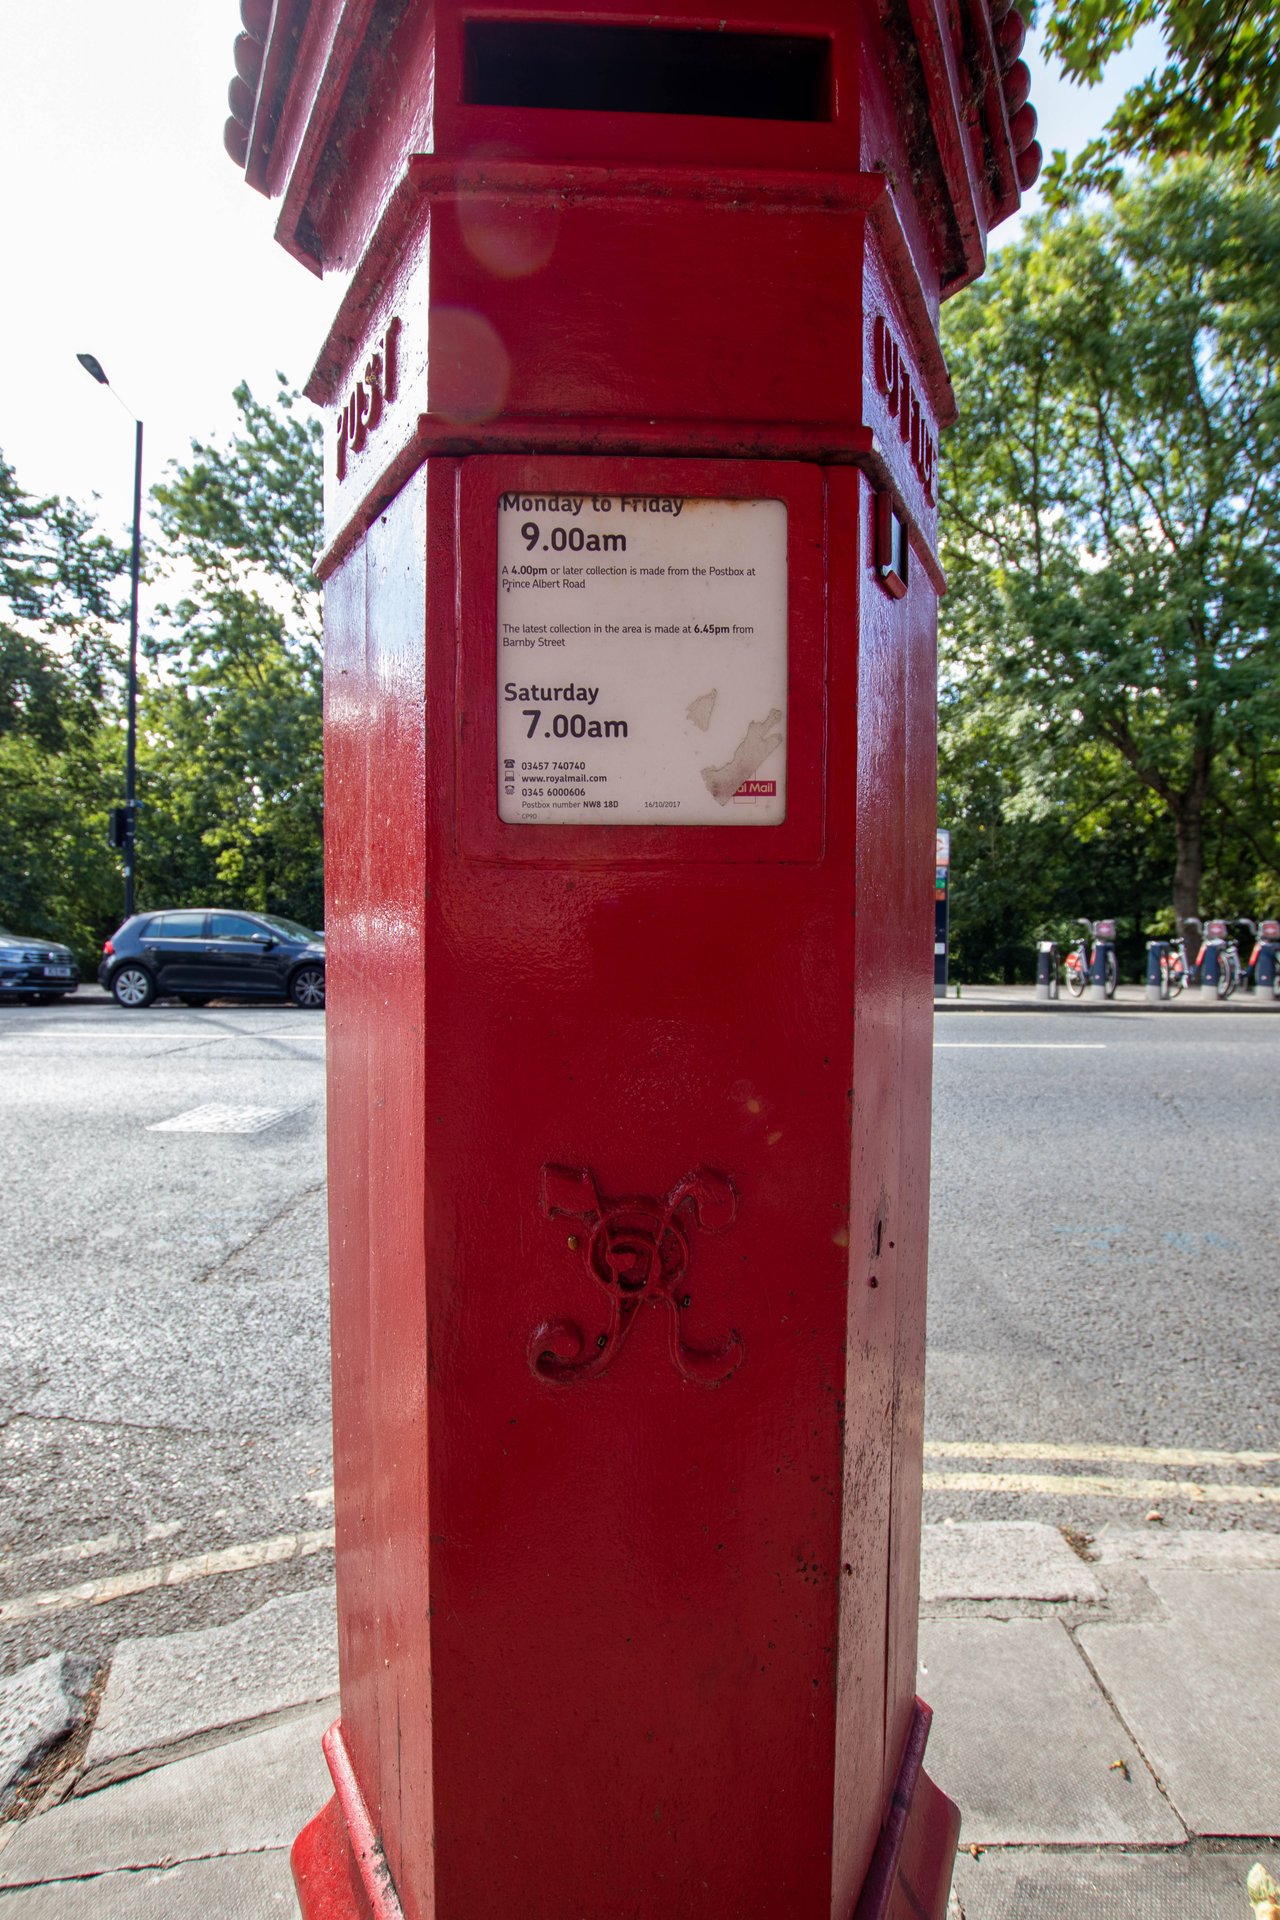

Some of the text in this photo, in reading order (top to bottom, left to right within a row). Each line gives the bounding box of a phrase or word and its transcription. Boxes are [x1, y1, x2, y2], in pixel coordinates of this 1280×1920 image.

[503, 494, 684, 517] Monday to Friday
[521, 522, 627, 552] 9.00am
[502, 565, 756, 577] A 4.00pm or later collection is made from the Postbox at
[502, 579, 586, 589] Prince Albert Road
[502, 624, 754, 635] The latest collection in the area is made at 6.45pm from
[502, 637, 566, 648] Barnby Street
[504, 682, 600, 706] Saturday
[522, 709, 628, 739] 7.00am
[521, 761, 586, 770] 03457 740740
[521, 774, 608, 784] www.royalmail.com
[521, 788, 586, 797] 0345 6000606
[749, 783, 773, 793] Mail
[521, 800, 551, 809] Postbox
[552, 800, 581, 809] number
